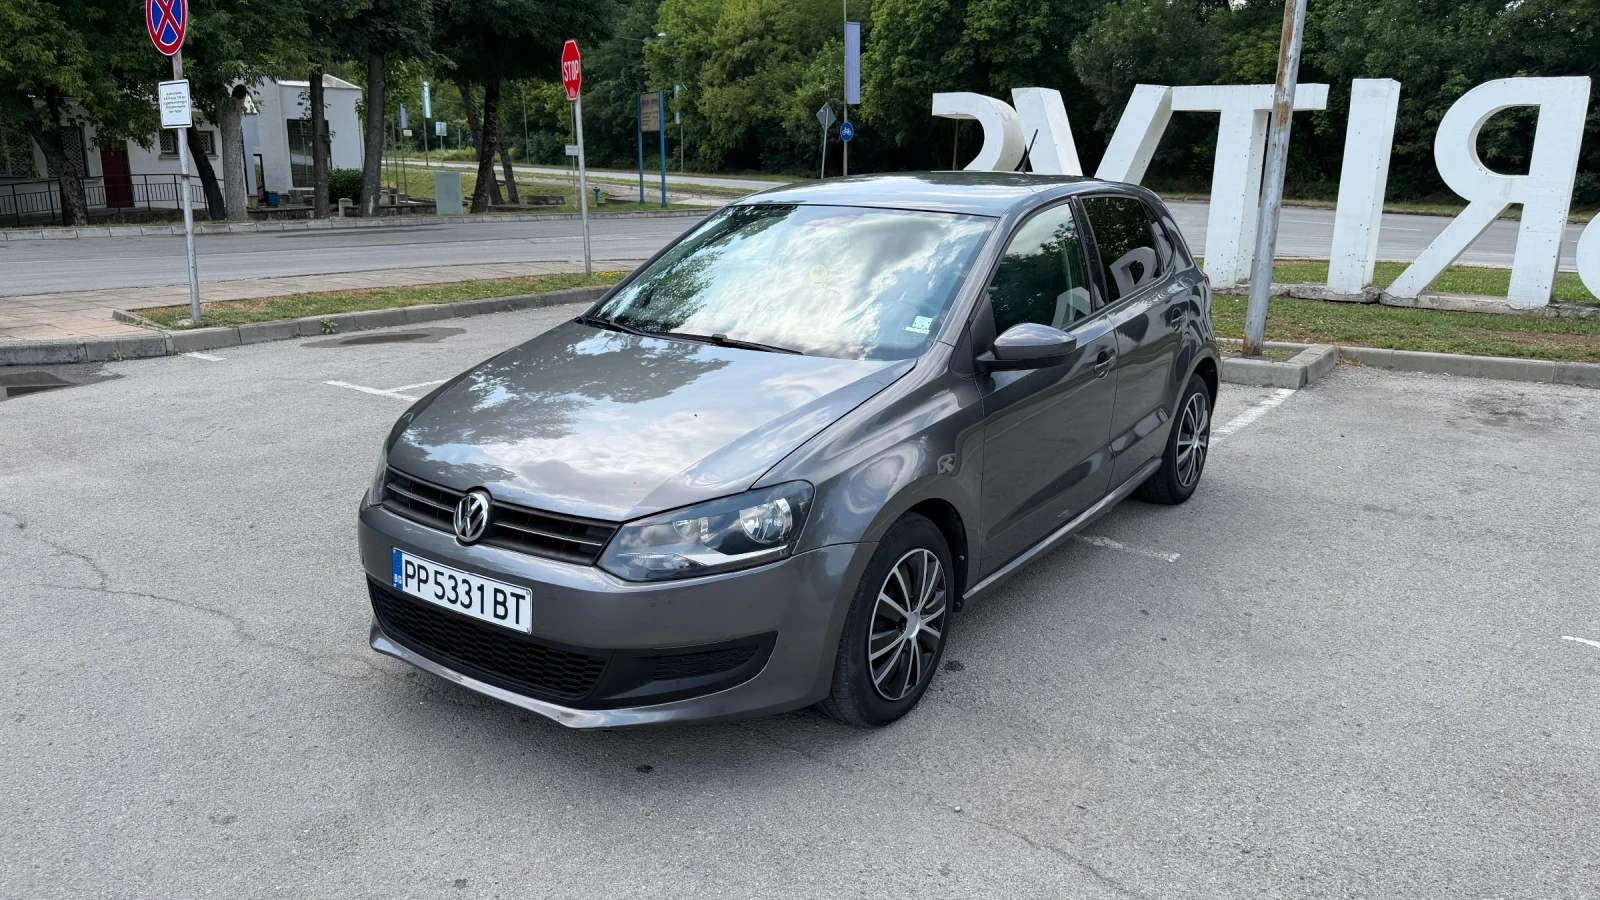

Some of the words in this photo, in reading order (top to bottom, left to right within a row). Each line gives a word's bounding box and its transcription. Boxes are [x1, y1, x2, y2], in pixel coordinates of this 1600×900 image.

[563, 60, 579, 82] STOP
[404, 559, 429, 593] PP
[434, 569, 485, 615] 5331
[493, 587, 526, 625] BT
